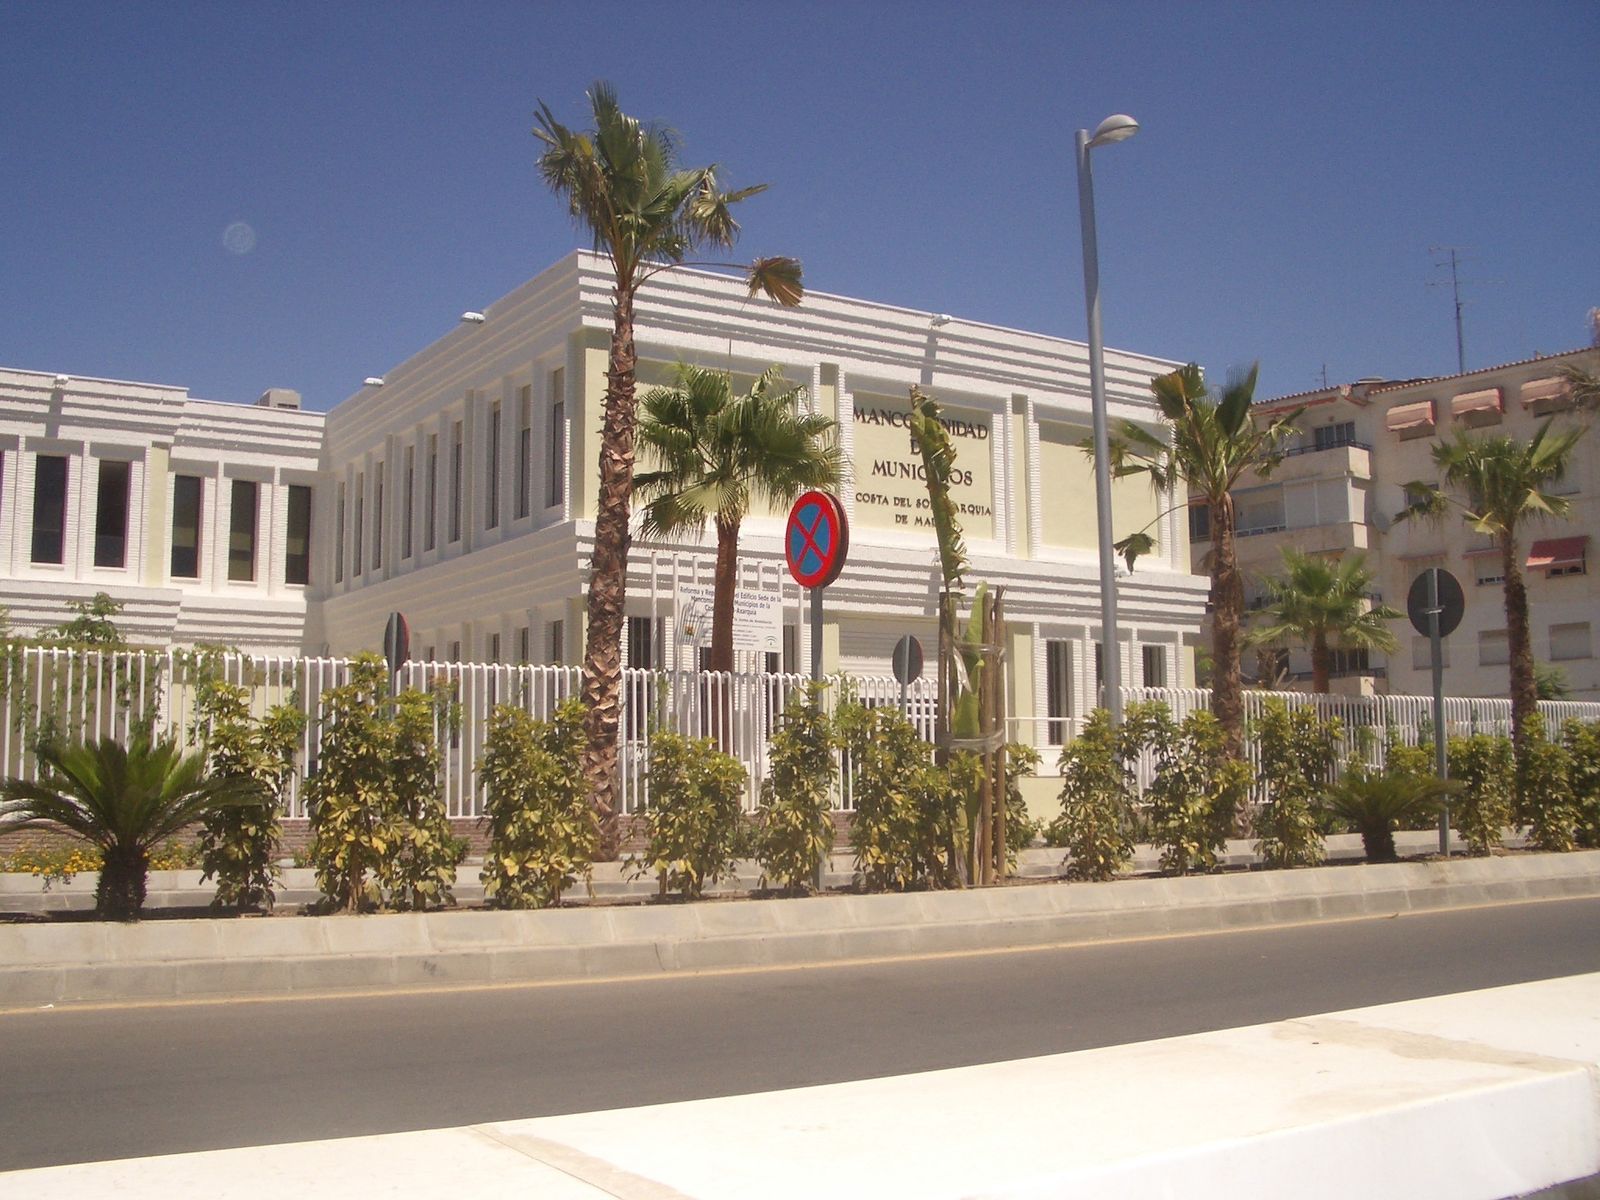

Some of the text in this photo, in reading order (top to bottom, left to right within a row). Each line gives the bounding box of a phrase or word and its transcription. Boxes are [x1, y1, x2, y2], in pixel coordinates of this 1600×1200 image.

[853, 407, 988, 440] MANCONIDAD
[855, 492, 889, 506] COSTA
[893, 496, 912, 508] DEL
[916, 498, 932, 509] SO
[895, 514, 908, 524] DE
[758, 594, 769, 602] Sede
